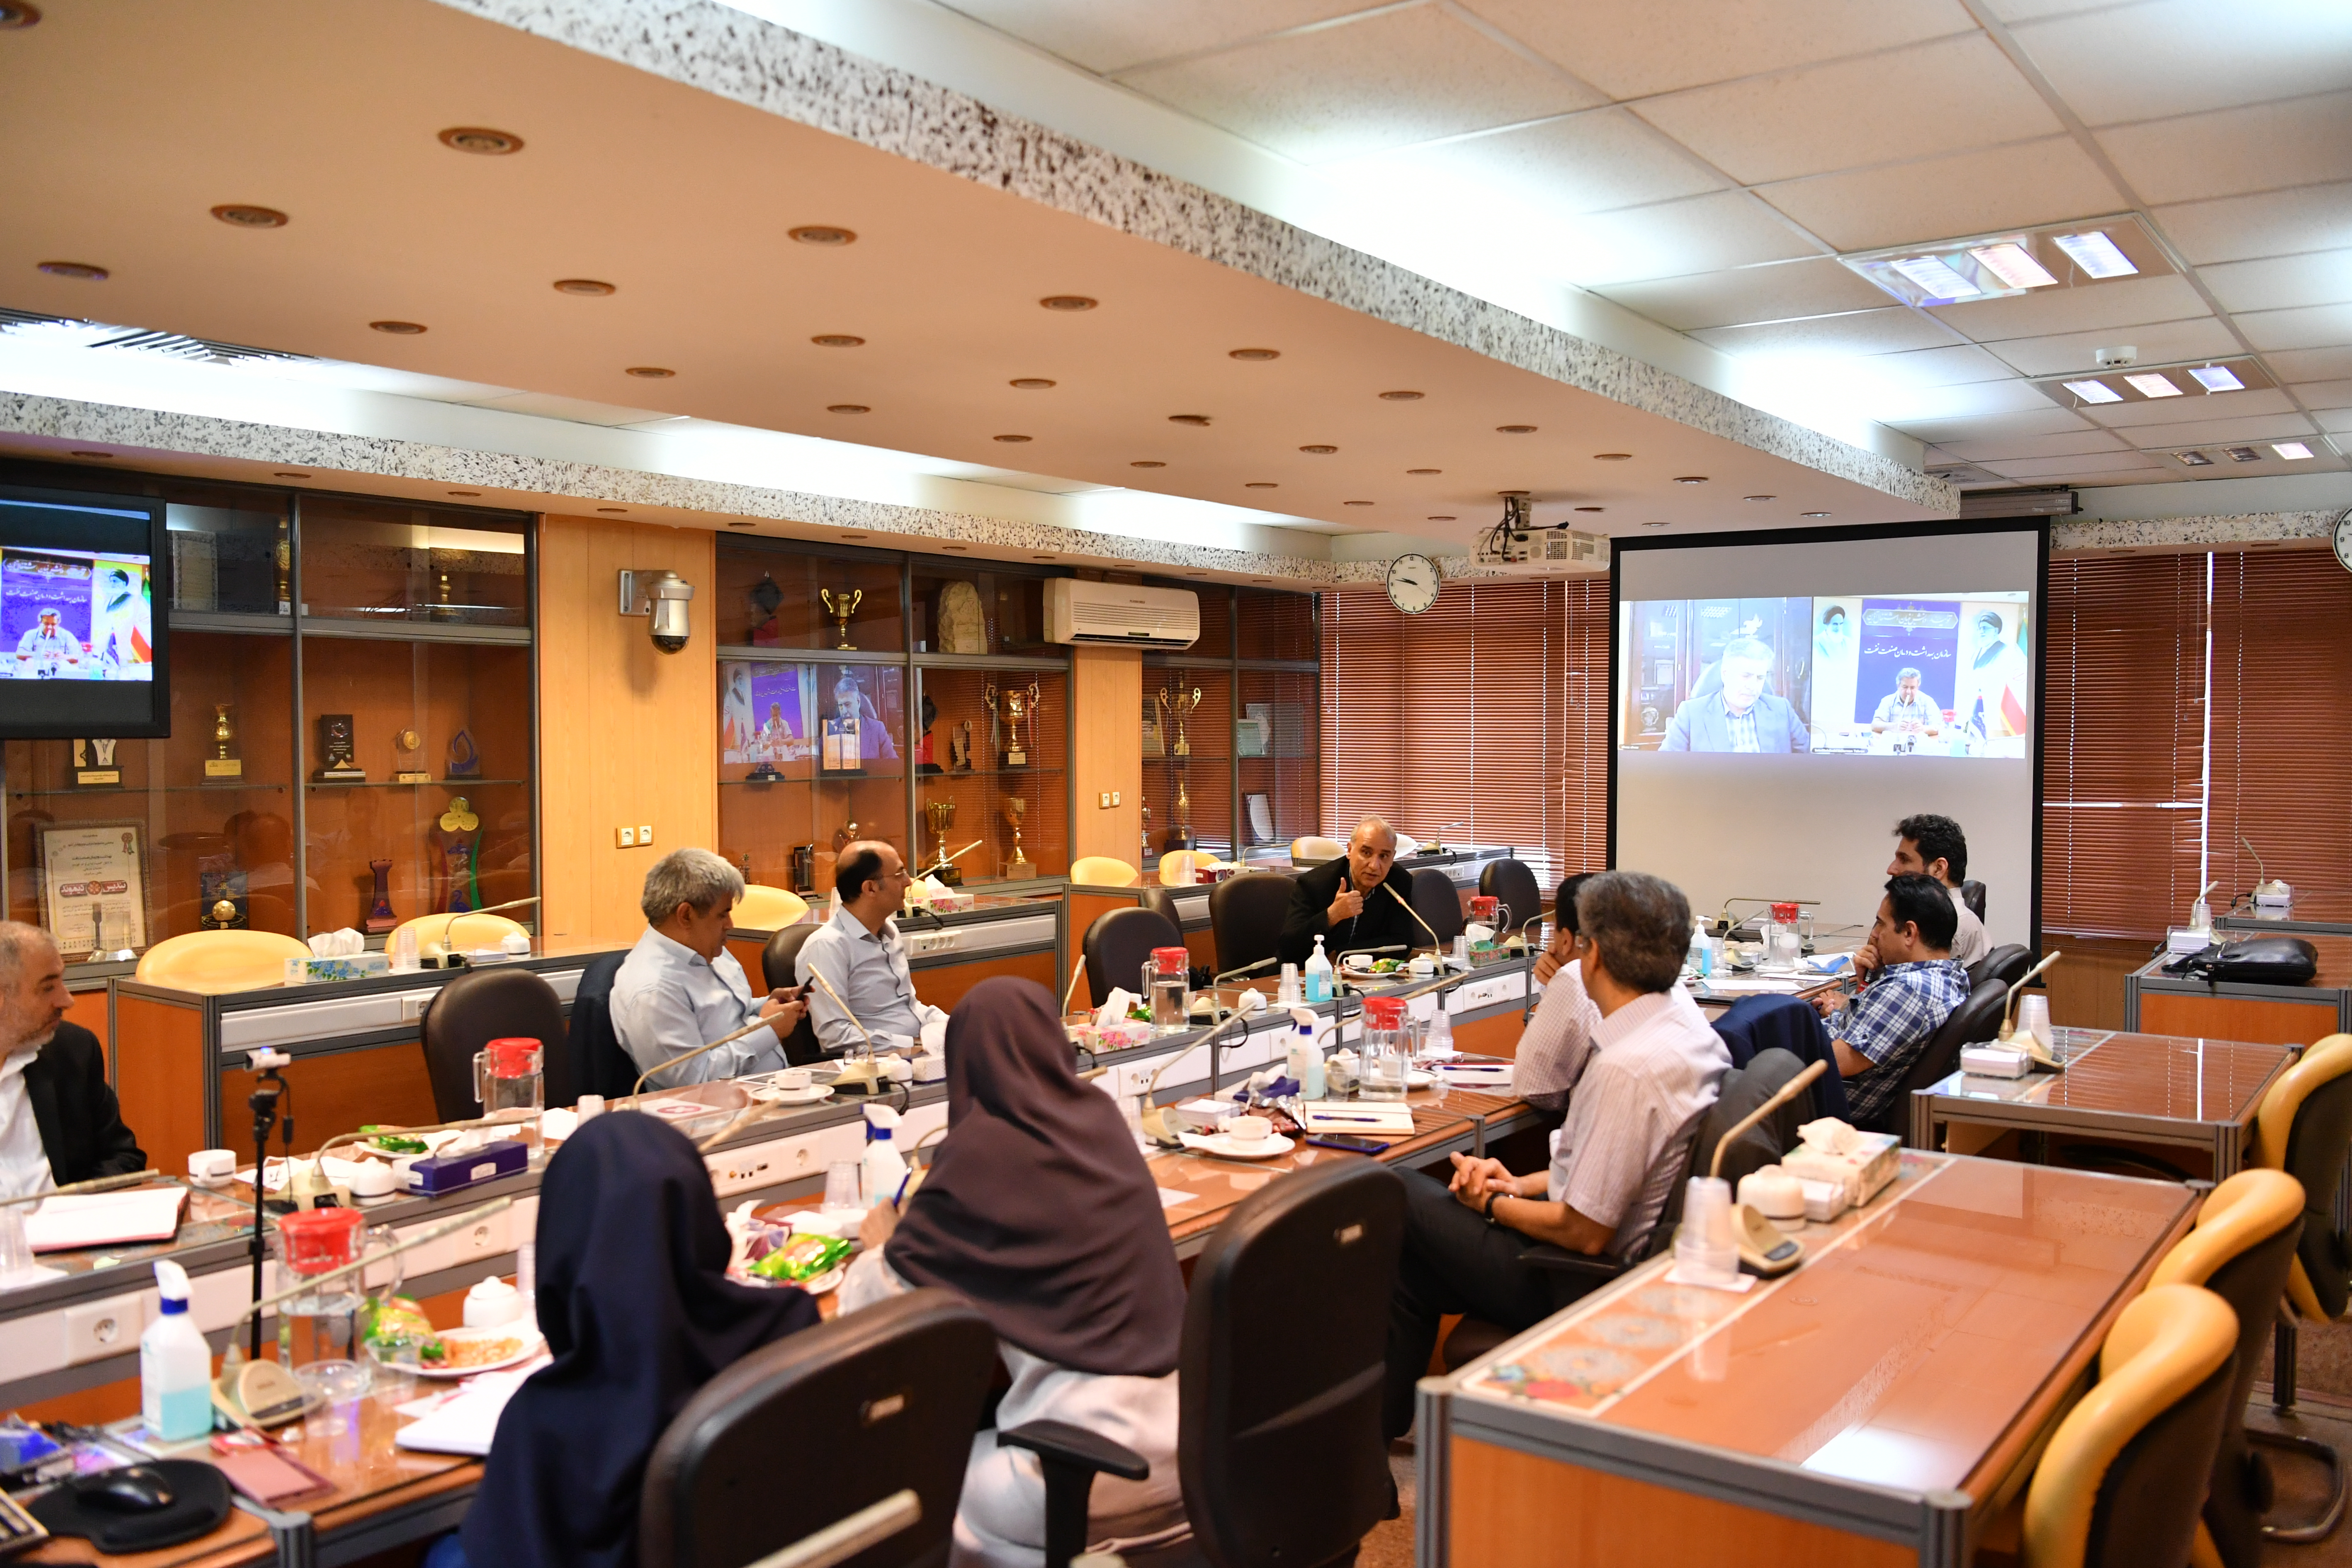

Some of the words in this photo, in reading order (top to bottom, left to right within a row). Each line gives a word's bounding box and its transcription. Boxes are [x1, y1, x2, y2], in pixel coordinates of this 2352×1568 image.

[6, 586, 21, 596] نفت
[71, 595, 87, 603] سازمان
[1864, 643, 1880, 654] نفت
[1878, 645, 1898, 654] صنعت
[1894, 649, 1908, 658] درمان
[1911, 645, 1935, 660] بهداشت
[1933, 649, 1952, 659] سازمان
